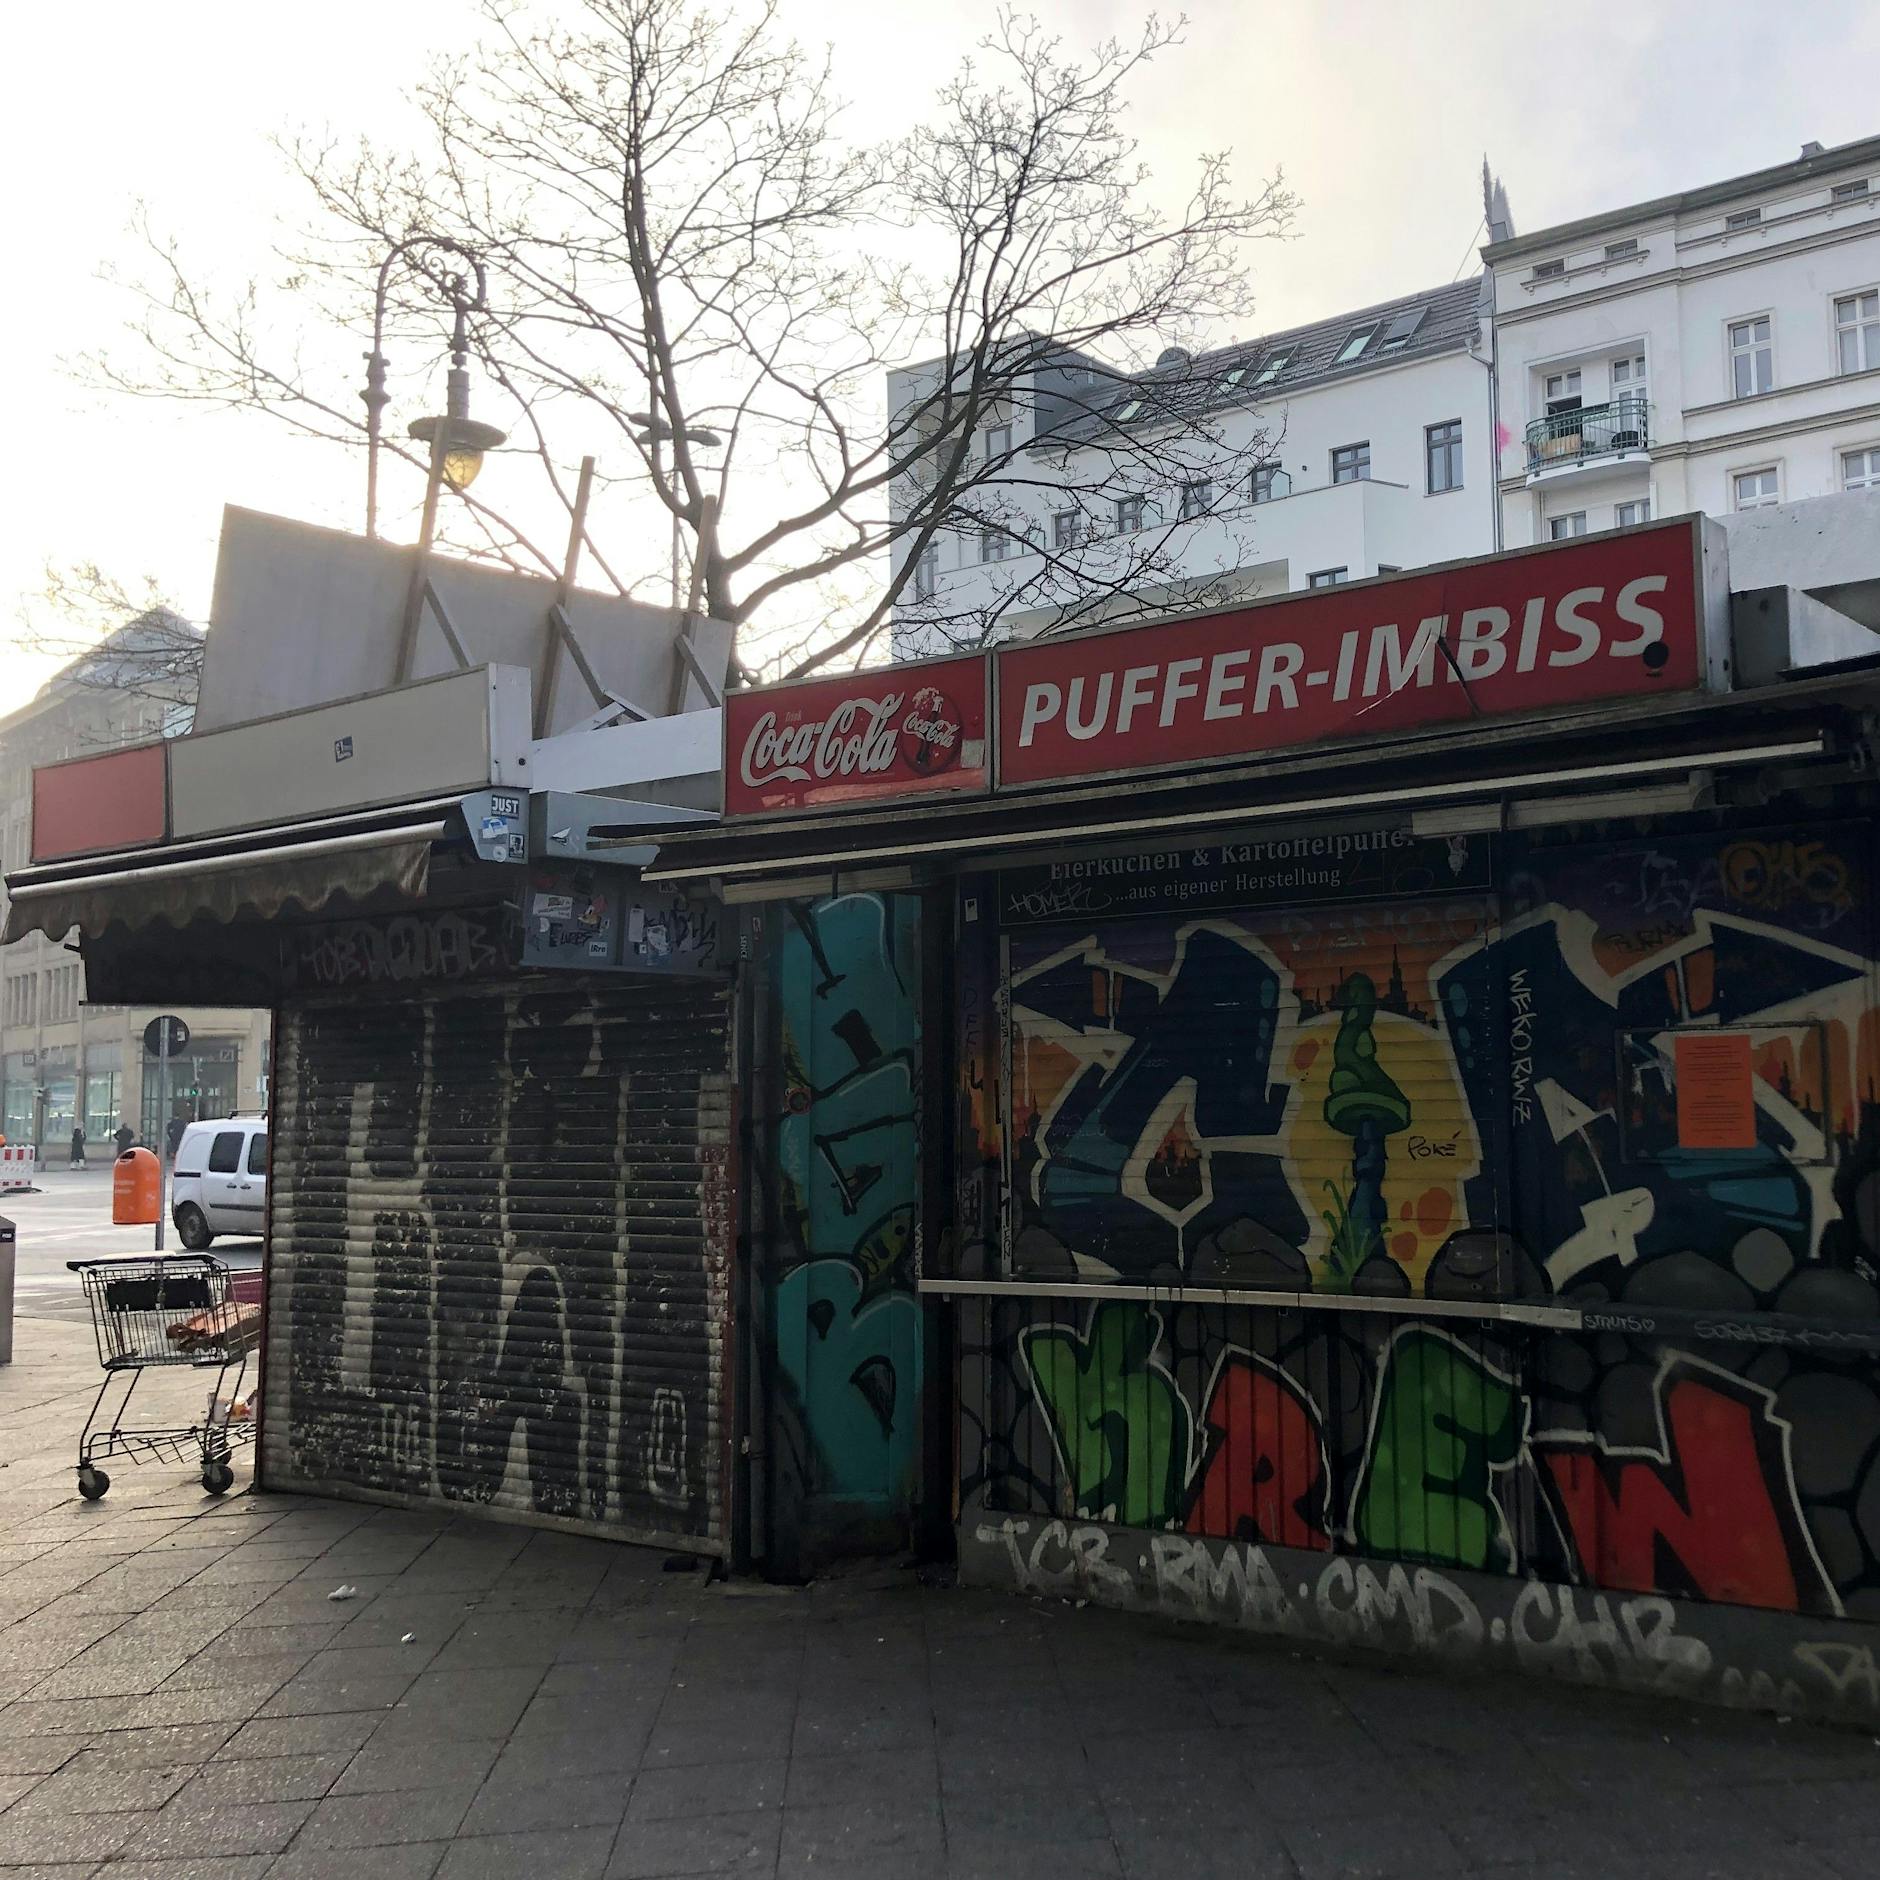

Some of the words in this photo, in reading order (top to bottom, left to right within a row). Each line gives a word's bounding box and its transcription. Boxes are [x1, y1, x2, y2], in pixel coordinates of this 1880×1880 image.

[1017, 575, 1669, 748] PUFFER-IMBISS
[741, 692, 905, 787] Coca-Cola
[902, 711, 961, 748] Coca-Cola
[492, 796, 519, 814] JUST
[1051, 852, 1181, 880] Eierkuchen
[1192, 848, 1210, 867] &
[1164, 878, 1228, 900] eigener
[1236, 867, 1341, 892] Herstellung
